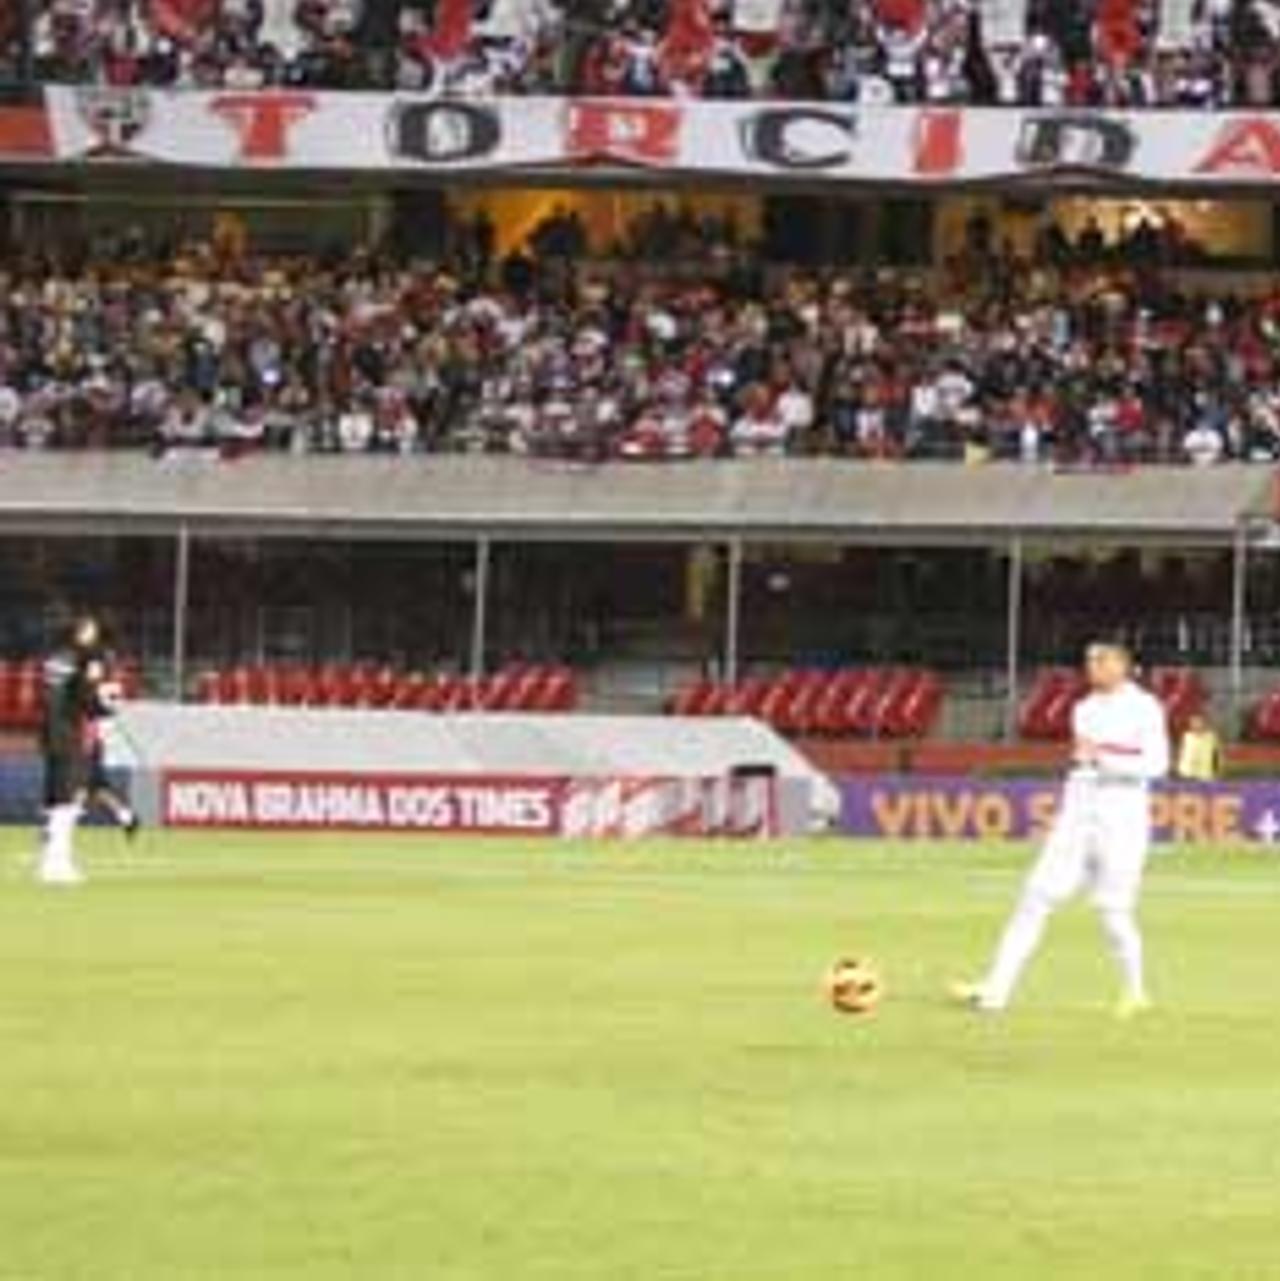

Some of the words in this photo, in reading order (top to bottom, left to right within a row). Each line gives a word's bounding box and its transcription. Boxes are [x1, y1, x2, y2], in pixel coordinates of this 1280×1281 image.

[168, 781, 249, 819] NOVA
[254, 783, 385, 822] BRAHMA
[388, 786, 450, 825] DOS
[453, 787, 551, 827] TIMES
[872, 791, 1011, 838] VIVO
[1029, 793, 1242, 840] SPRE
